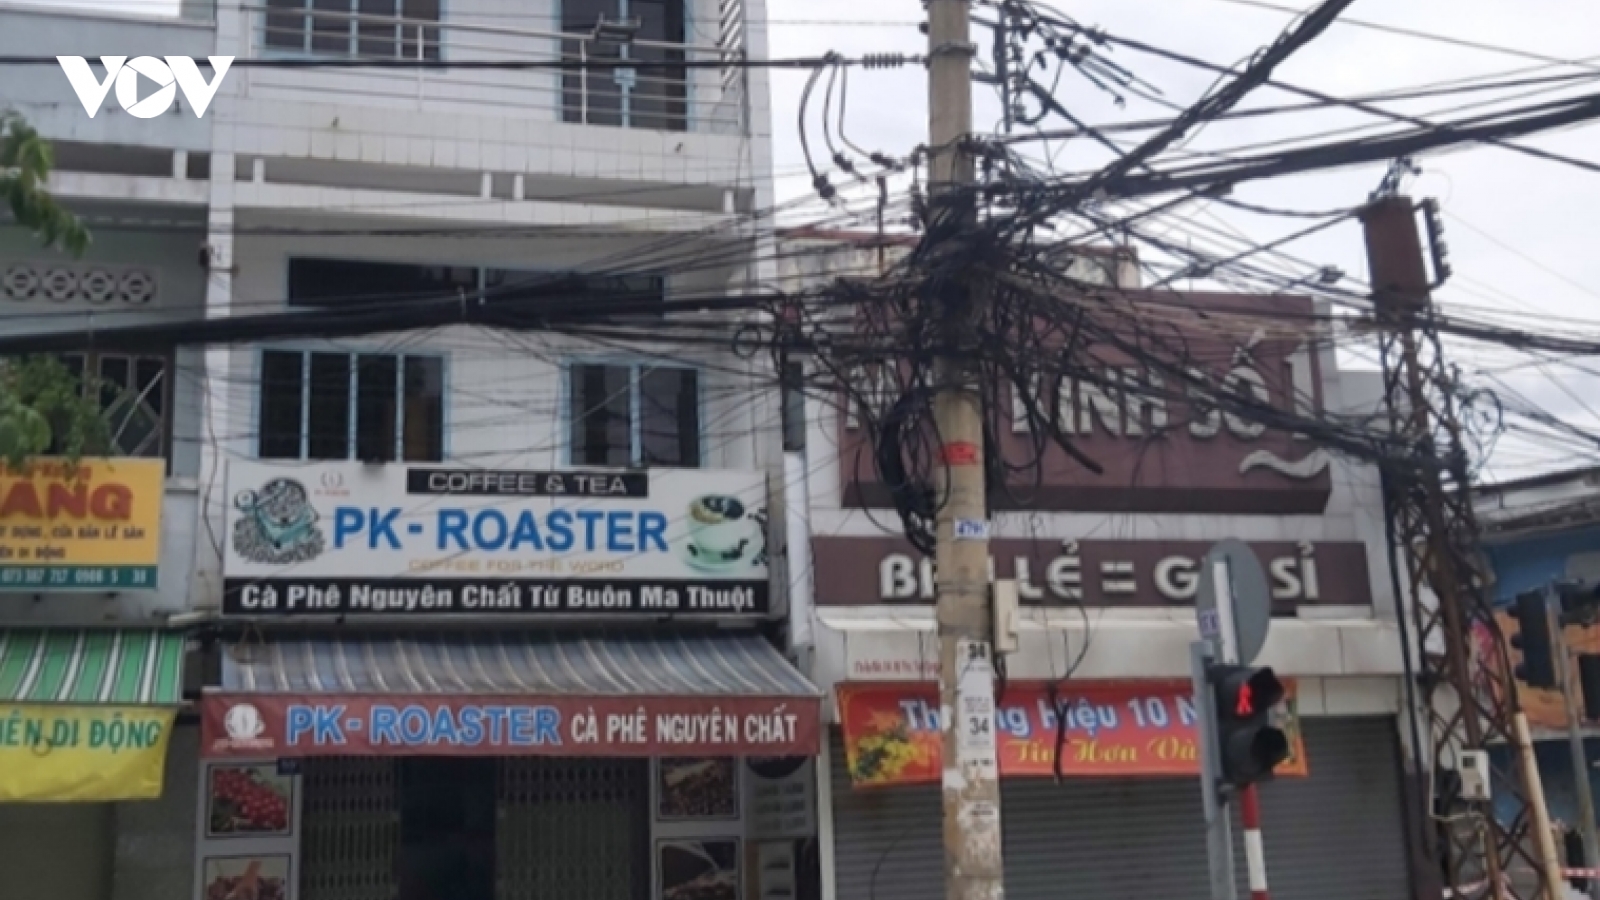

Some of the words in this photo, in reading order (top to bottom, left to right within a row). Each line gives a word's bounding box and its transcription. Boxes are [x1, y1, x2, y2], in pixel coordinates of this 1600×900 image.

[429, 473, 536, 492] COFFEE
[545, 474, 565, 492] &
[575, 475, 627, 494] TEA
[438, 508, 669, 551] ROASTER
[1015, 539, 1084, 599] LẺ
[1269, 540, 1319, 599] SỈ
[240, 583, 279, 609] Cà
[286, 583, 342, 609] Phê
[349, 583, 453, 612] Nguyên
[461, 581, 522, 608] Chất
[566, 584, 633, 609] Buôn
[640, 586, 680, 609] Ma
[686, 586, 755, 613] Thuột
[368, 704, 562, 747] ROASTER
[570, 706, 599, 743] CÀ
[606, 705, 648, 743] PHÊ
[655, 706, 739, 743] NGUYÊN
[743, 703, 798, 743] CHẤT
[1128, 697, 1168, 727] 10
[53, 718, 80, 747] DI
